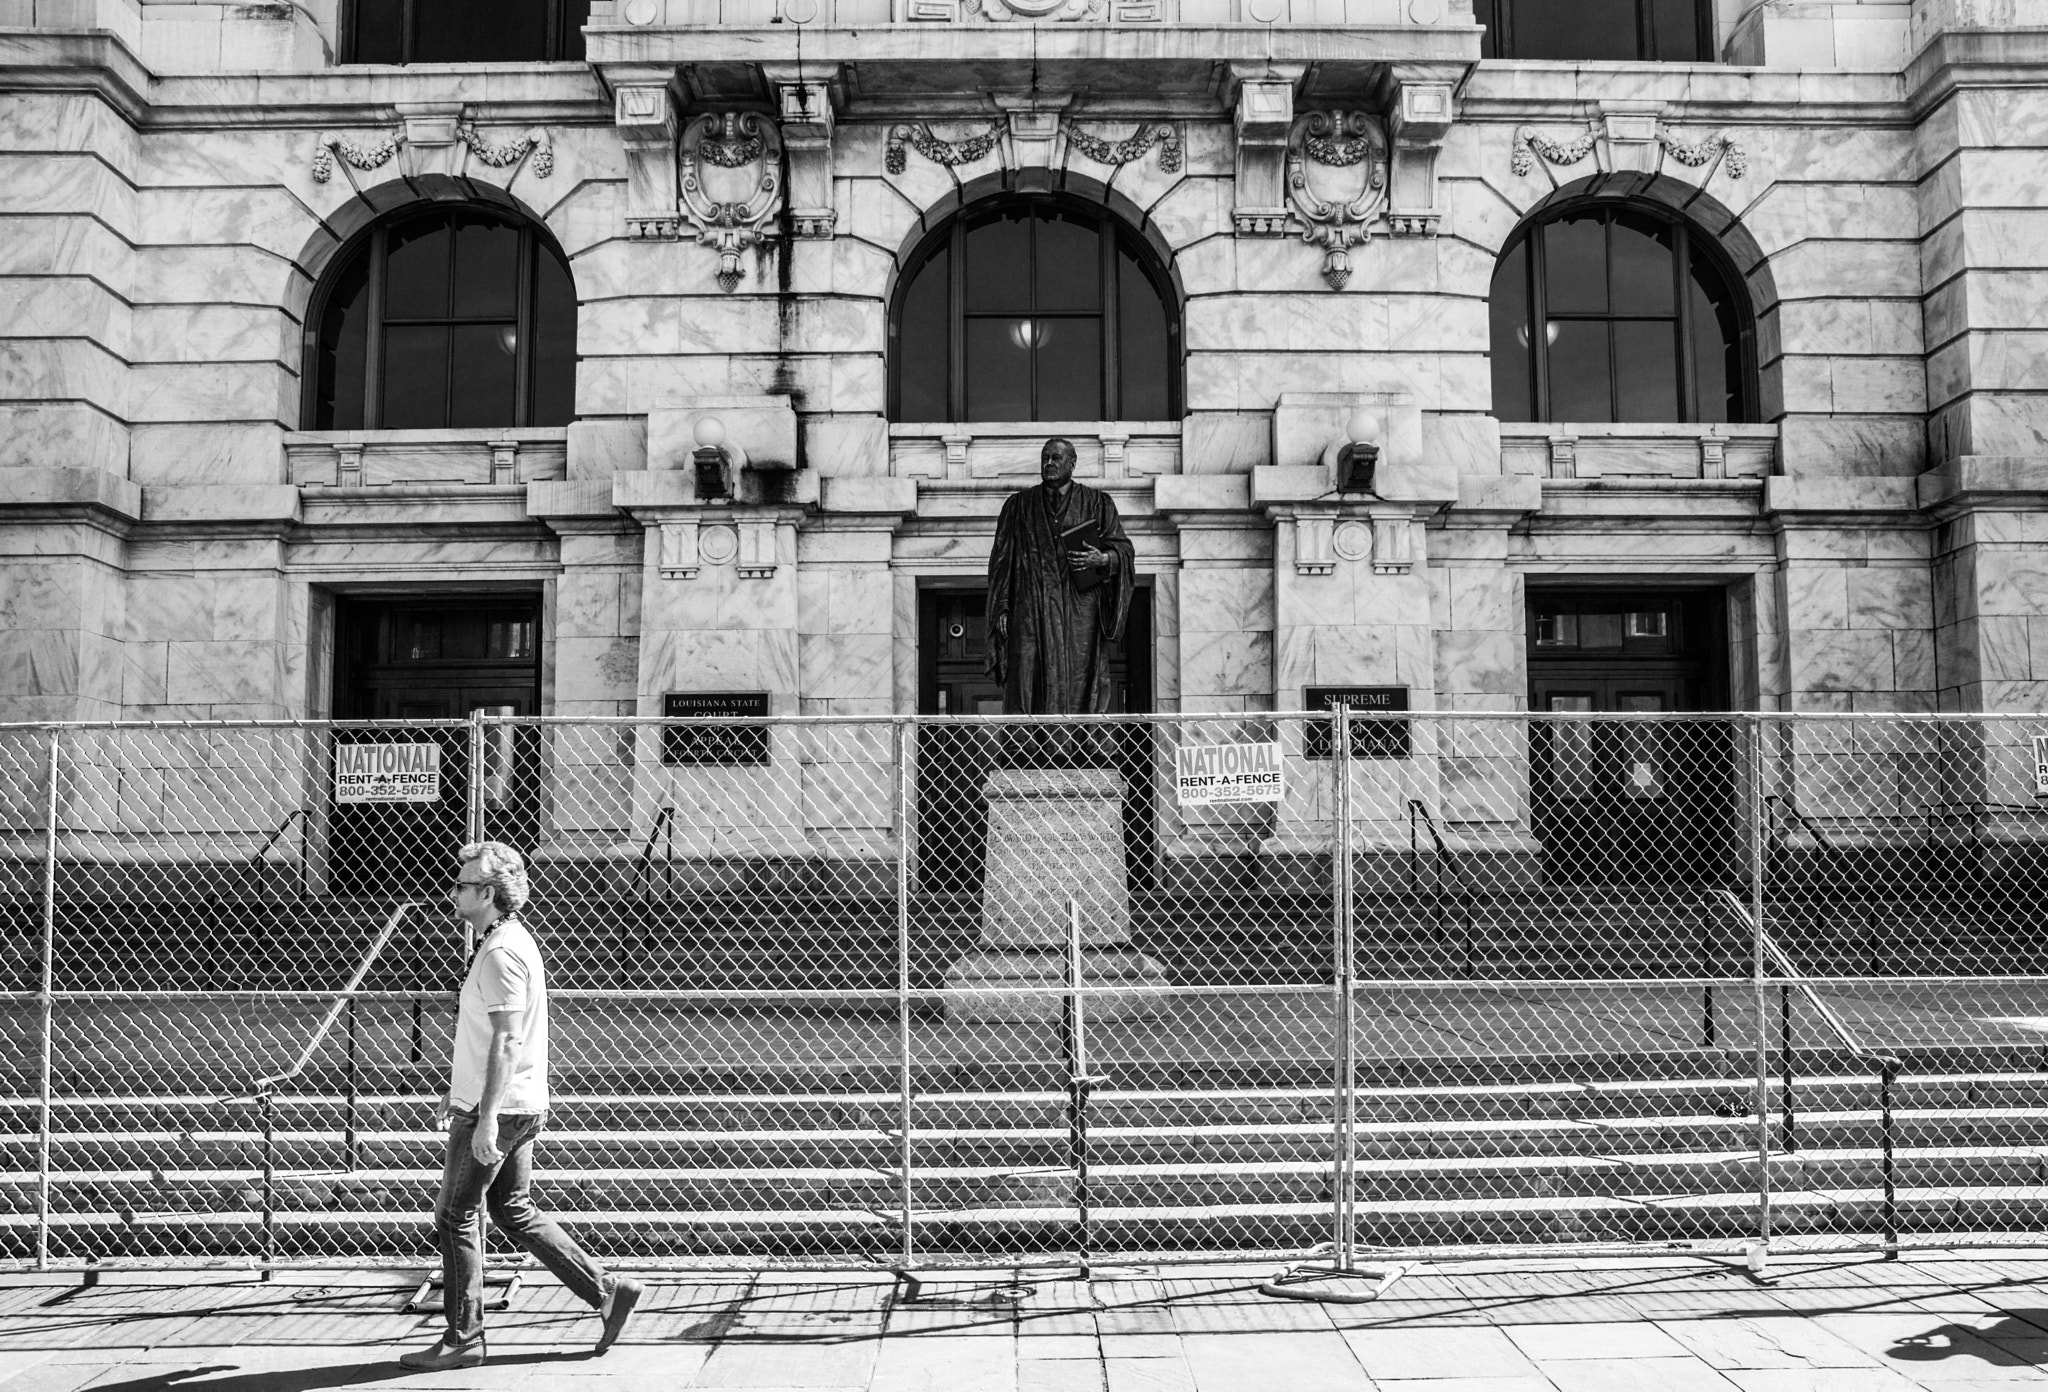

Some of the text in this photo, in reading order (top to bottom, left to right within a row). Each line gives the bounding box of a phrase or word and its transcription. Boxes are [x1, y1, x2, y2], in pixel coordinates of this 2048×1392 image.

[672, 699, 760, 708] LOUISIANA STATE
[1324, 694, 1391, 706] SUPREME
[1350, 725, 1366, 734] OF
[691, 736, 741, 746] APPEAL
[339, 744, 437, 774] NATIONAL
[1178, 744, 1280, 776] NATIONAL
[339, 773, 436, 785] RENT-A-FENCE
[1180, 773, 1281, 787] RENT-A-FENCE
[339, 784, 435, 796] 800-352-5675
[1181, 784, 1281, 799] 800-352-5675
